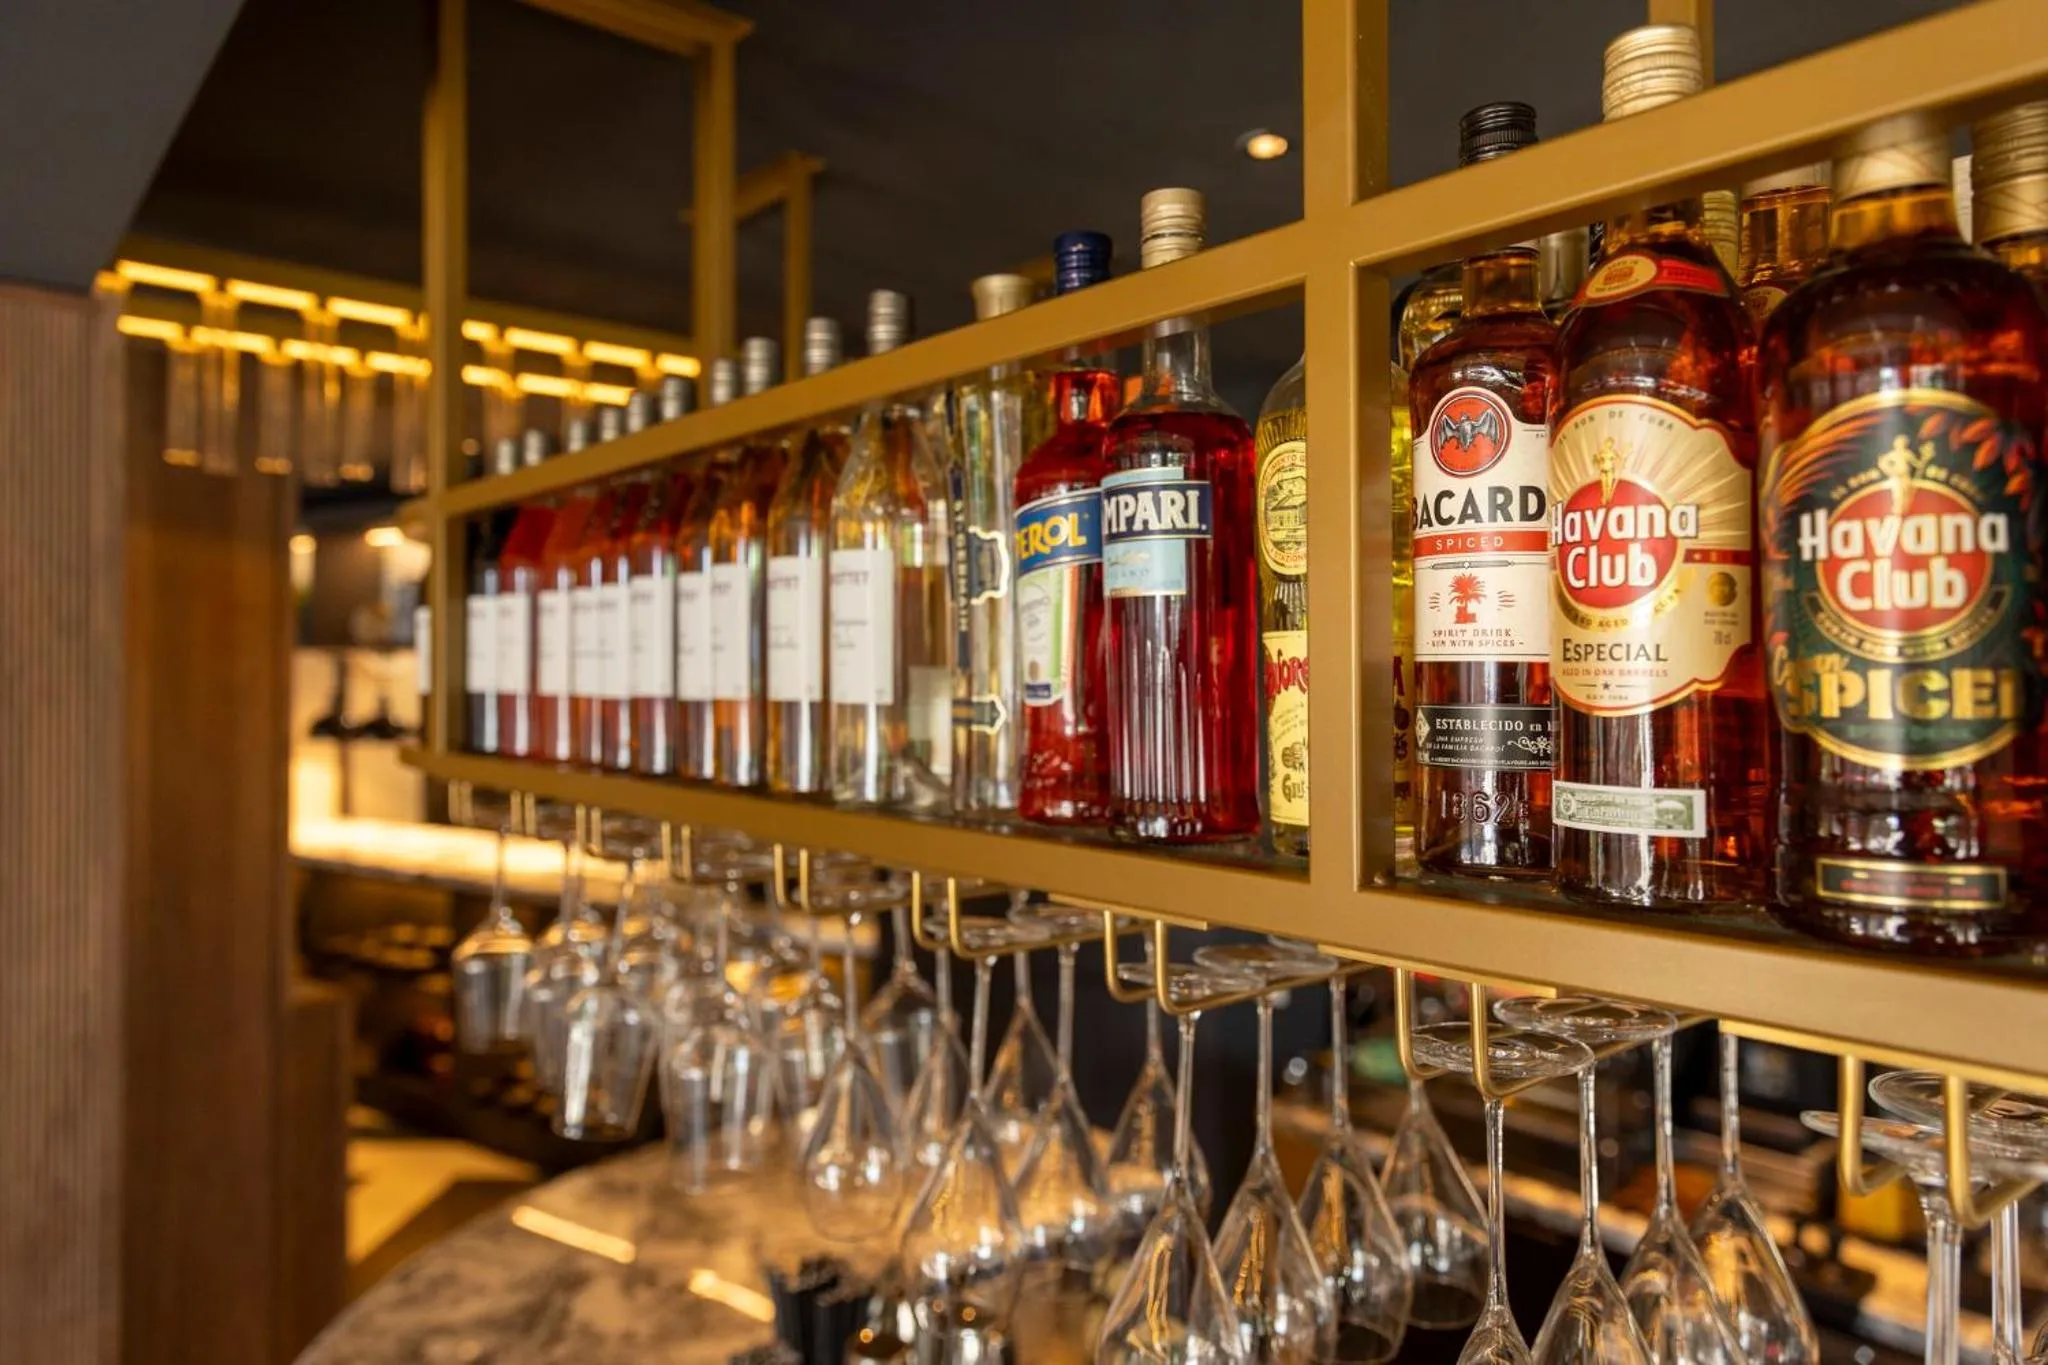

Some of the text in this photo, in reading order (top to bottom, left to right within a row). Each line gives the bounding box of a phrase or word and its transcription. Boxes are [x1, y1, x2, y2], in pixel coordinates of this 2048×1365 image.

[1014, 512, 1088, 562] EROL
[1551, 500, 1700, 547] Havana
[1797, 507, 2010, 562] Havana
[1435, 536, 1505, 552] SPICED
[1566, 541, 1658, 588] Club
[1836, 556, 1968, 611] Club
[1432, 627, 1512, 638] SPIRIT DRINK
[1449, 639, 1475, 648] WITH
[1478, 639, 1516, 648] SPICES
[1562, 637, 1669, 662] ESPECIAL
[1435, 718, 1525, 732] ESTABLECIDO
